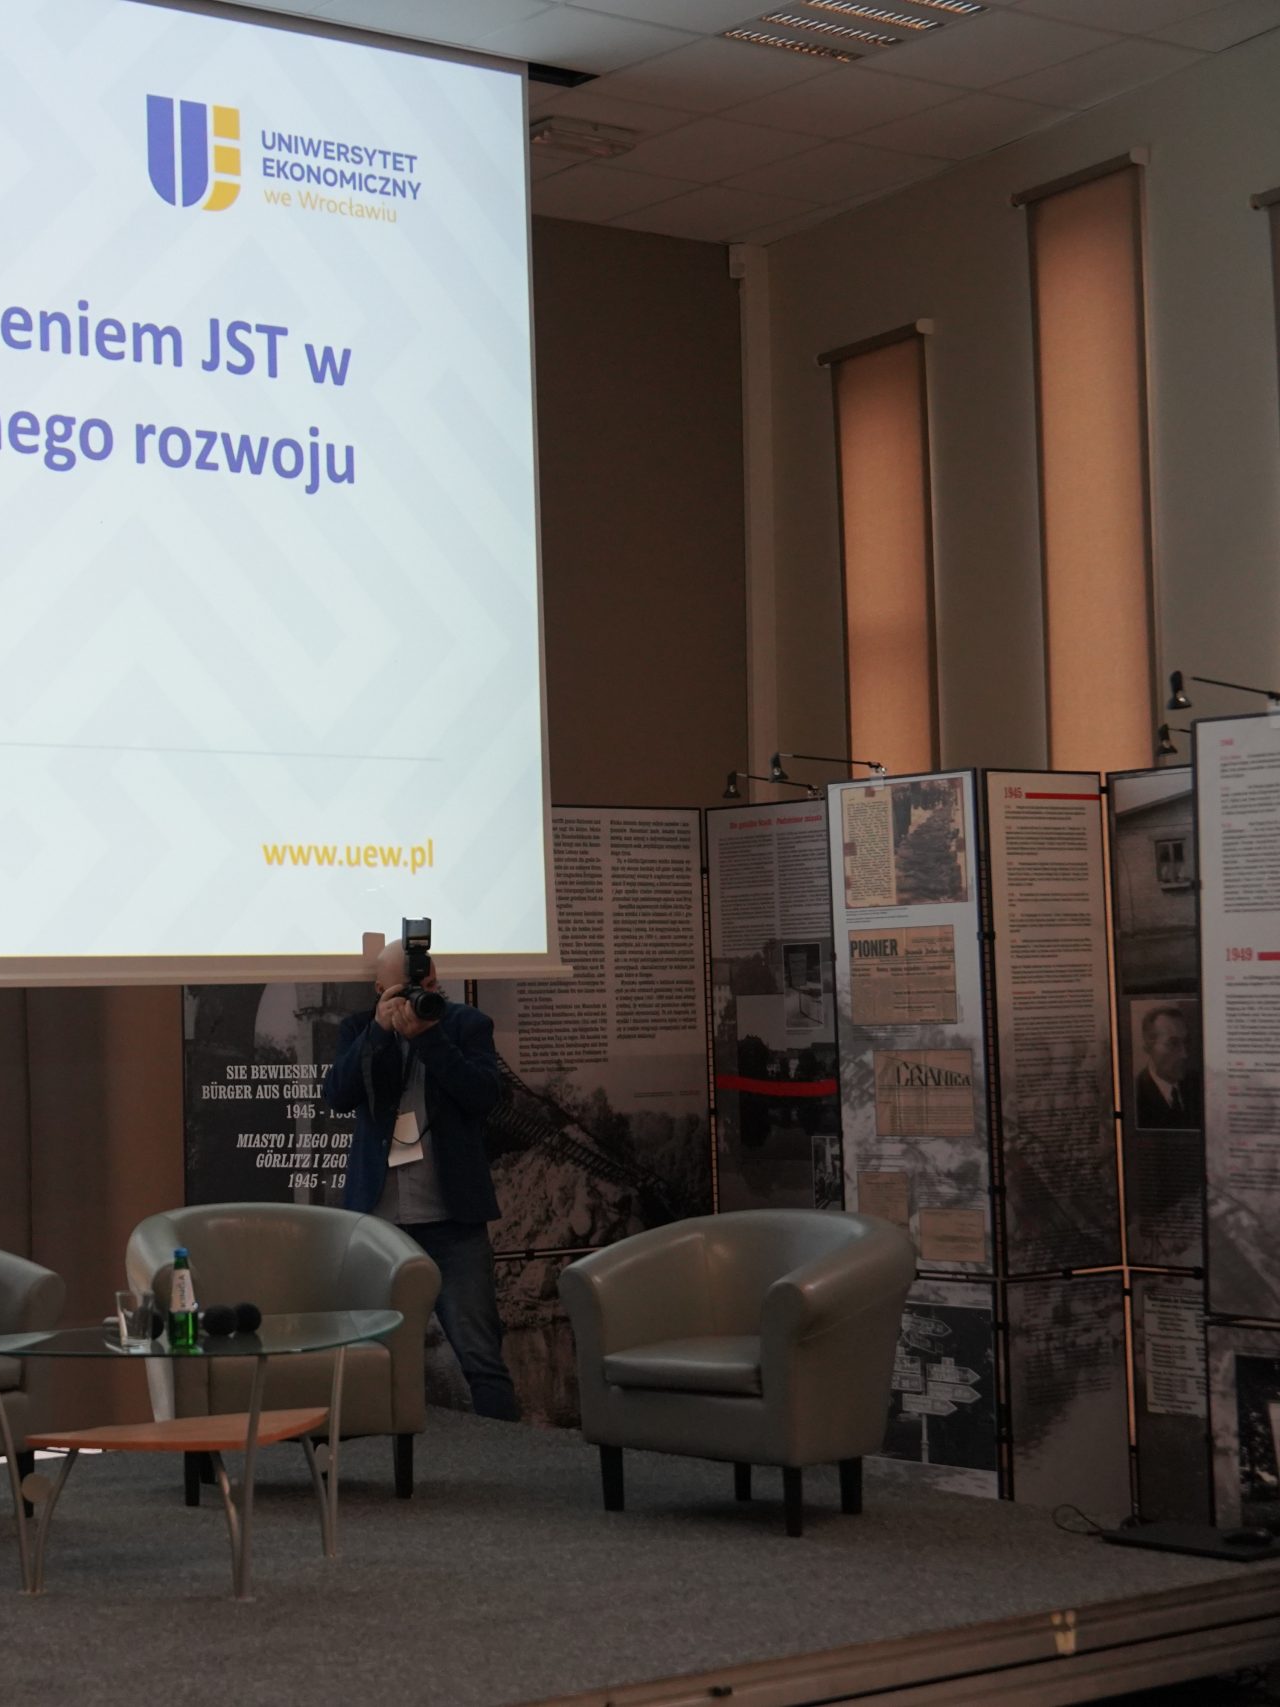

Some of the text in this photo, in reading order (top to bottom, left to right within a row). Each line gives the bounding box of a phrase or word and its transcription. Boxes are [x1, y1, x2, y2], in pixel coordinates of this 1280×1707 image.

[261, 129, 418, 174] UNIWERSYTET
[262, 157, 422, 201] EKONOMICZNY
[264, 189, 398, 223] we Wrocławiu
[201, 318, 289, 379] JST
[303, 343, 353, 387] w
[135, 424, 356, 496] rozwoju
[262, 838, 434, 875] www.uew.pl
[850, 938, 898, 957] PIONIER
[226, 1064, 248, 1080] SIE
[251, 1064, 317, 1079] BEWIESEN
[202, 1080, 324, 1100] BÜRGER AUS GÖRLI
[286, 1104, 316, 1119] 1945
[236, 1133, 286, 1149] MIASTO
[287, 1133, 296, 1148] I
[296, 1133, 328, 1148] JEGO
[256, 1149, 350, 1168] GÖRLITZ I ZGO
[287, 1173, 318, 1188] 1945
[331, 1174, 346, 1188] 19
